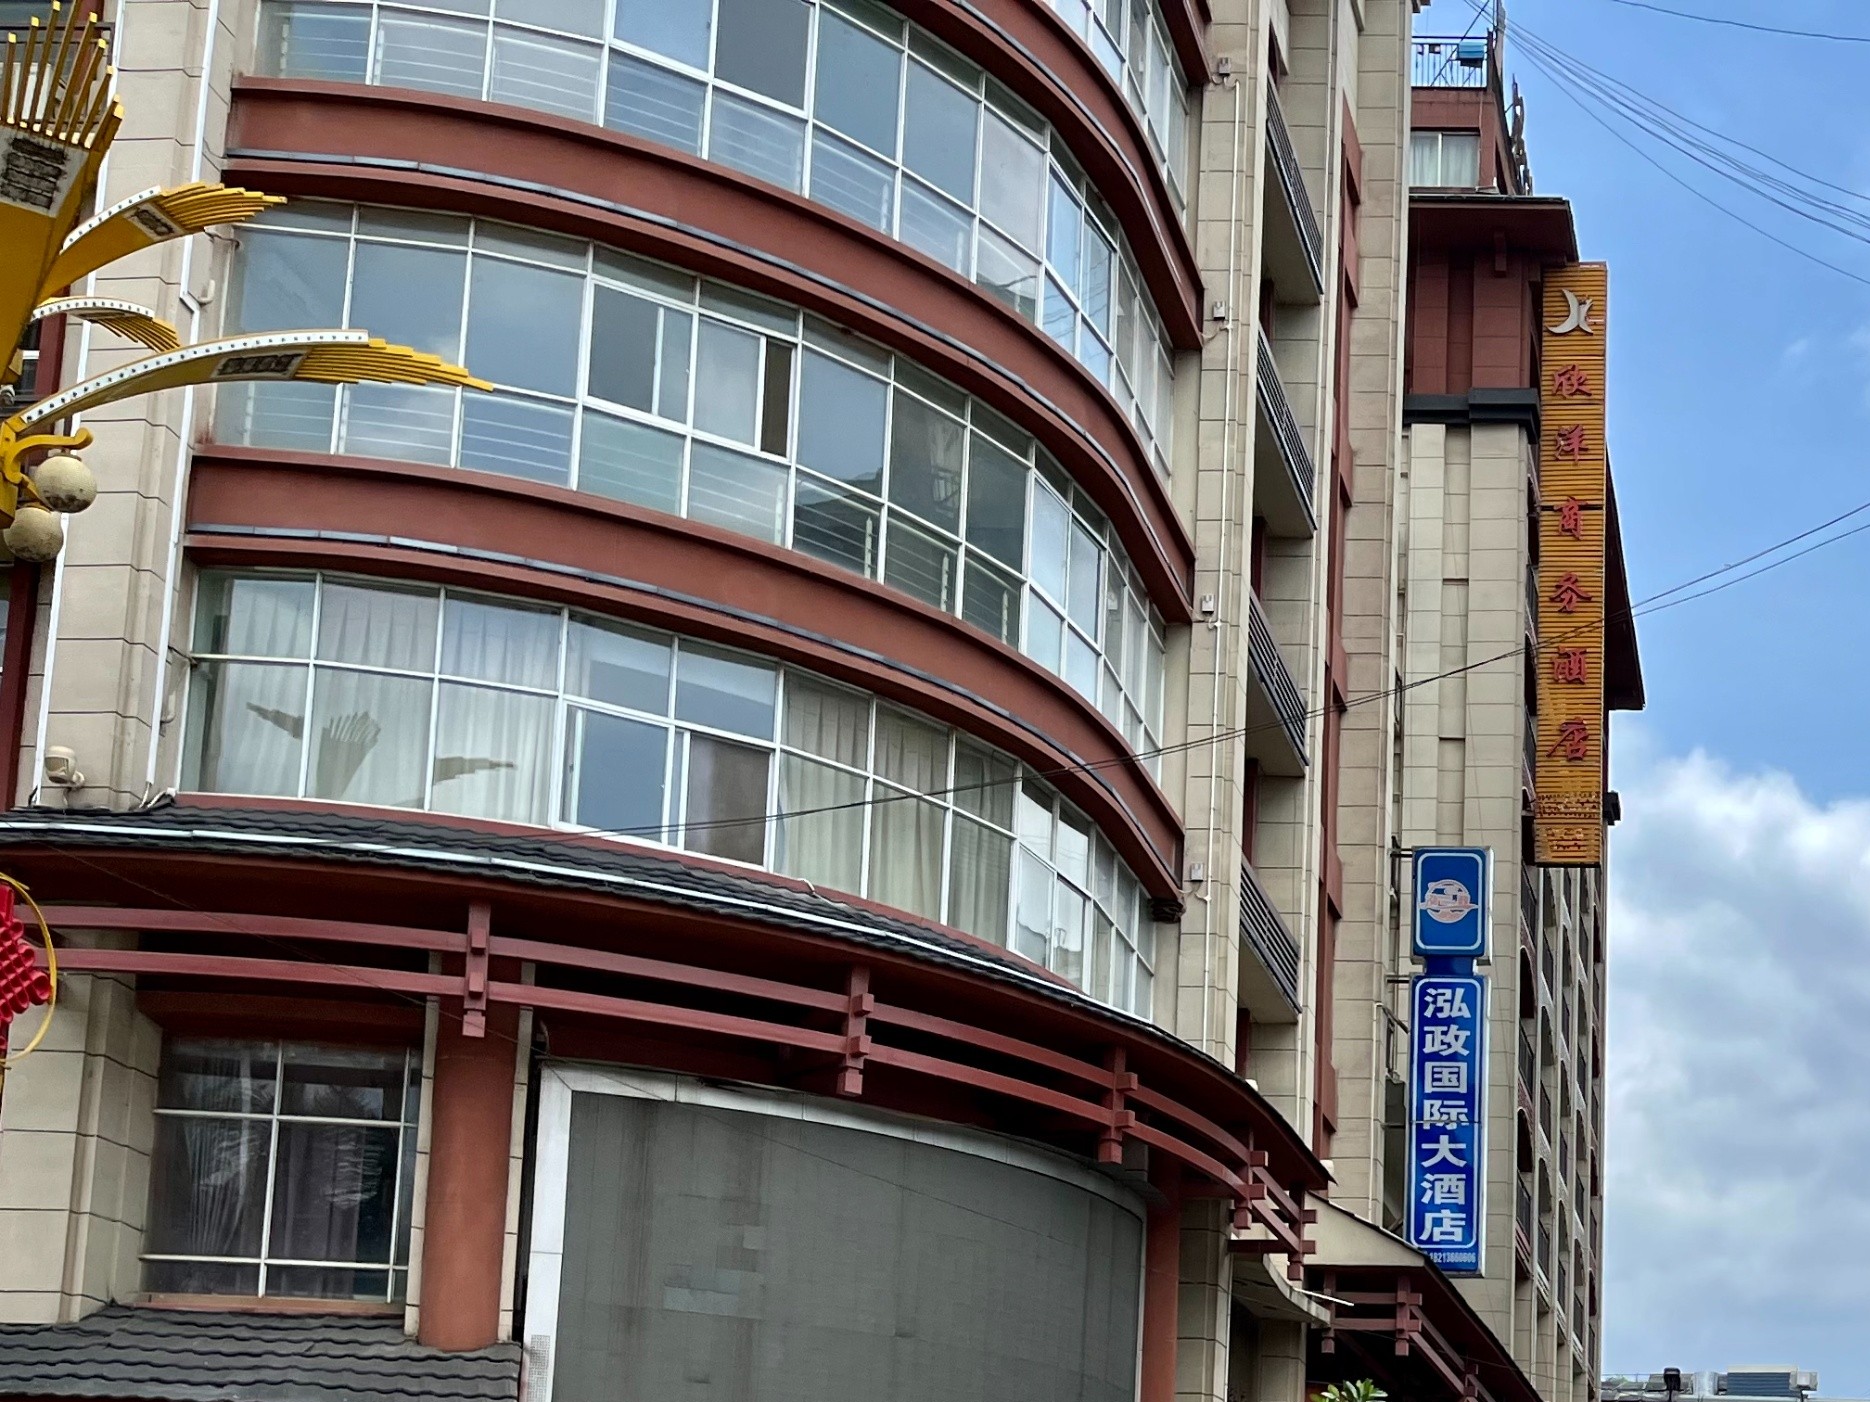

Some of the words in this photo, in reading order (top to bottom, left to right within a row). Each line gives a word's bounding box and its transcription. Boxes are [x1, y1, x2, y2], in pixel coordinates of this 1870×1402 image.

[1549, 363, 1592, 761] 欣洋商务酒店
[1419, 987, 1472, 1242] 泓政国际大酒店
